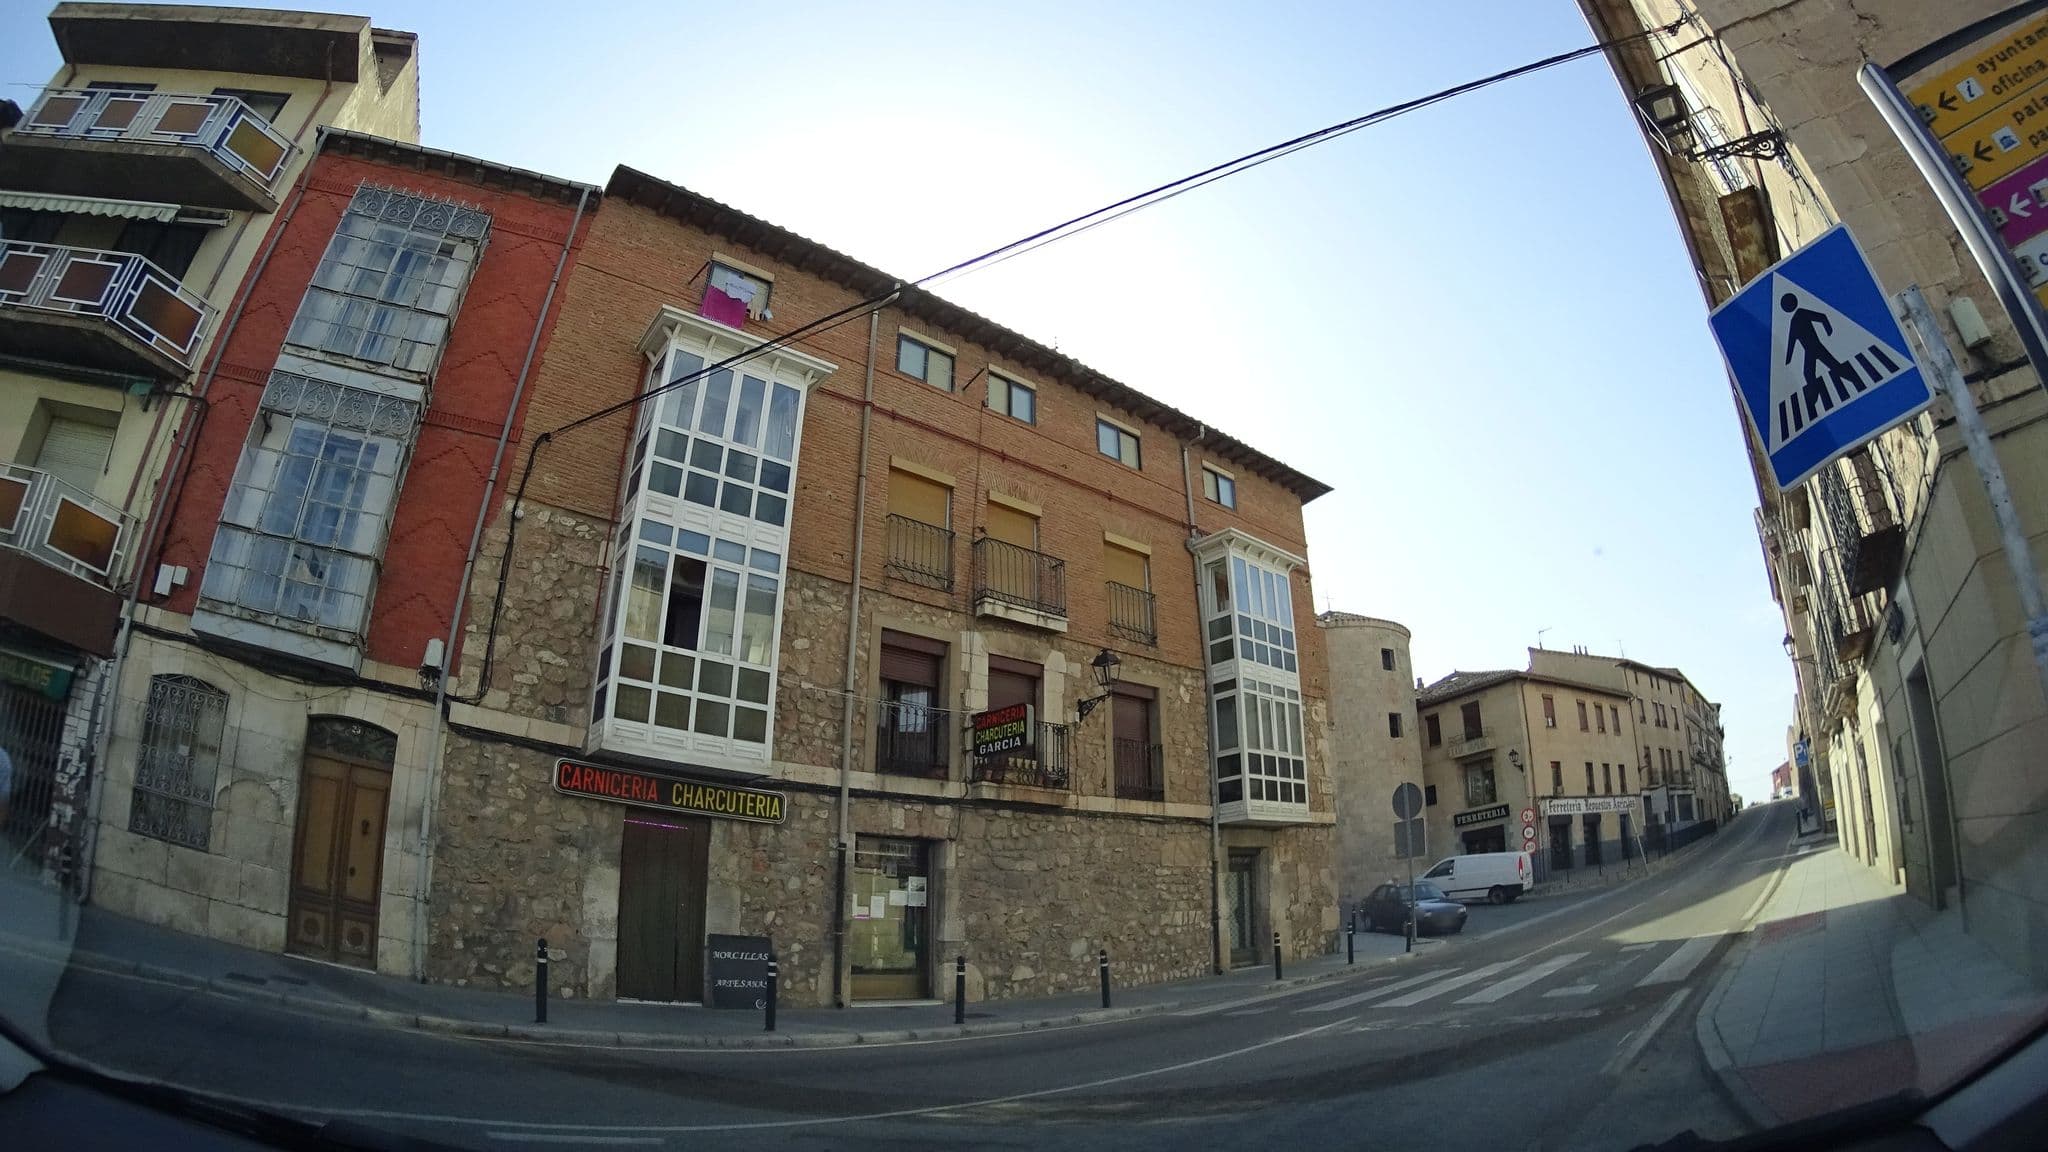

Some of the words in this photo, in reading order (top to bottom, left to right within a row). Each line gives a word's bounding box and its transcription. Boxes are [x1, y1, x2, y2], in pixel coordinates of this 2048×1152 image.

[1991, 59, 2047, 96] oficina
[975, 720, 1025, 744] CHARCUTERIA
[980, 737, 1021, 754] GARCIA
[560, 764, 659, 801] CARNICERIA
[672, 782, 781, 819] CHARCUTERIA
[1456, 807, 1507, 825] FERRETERIA
